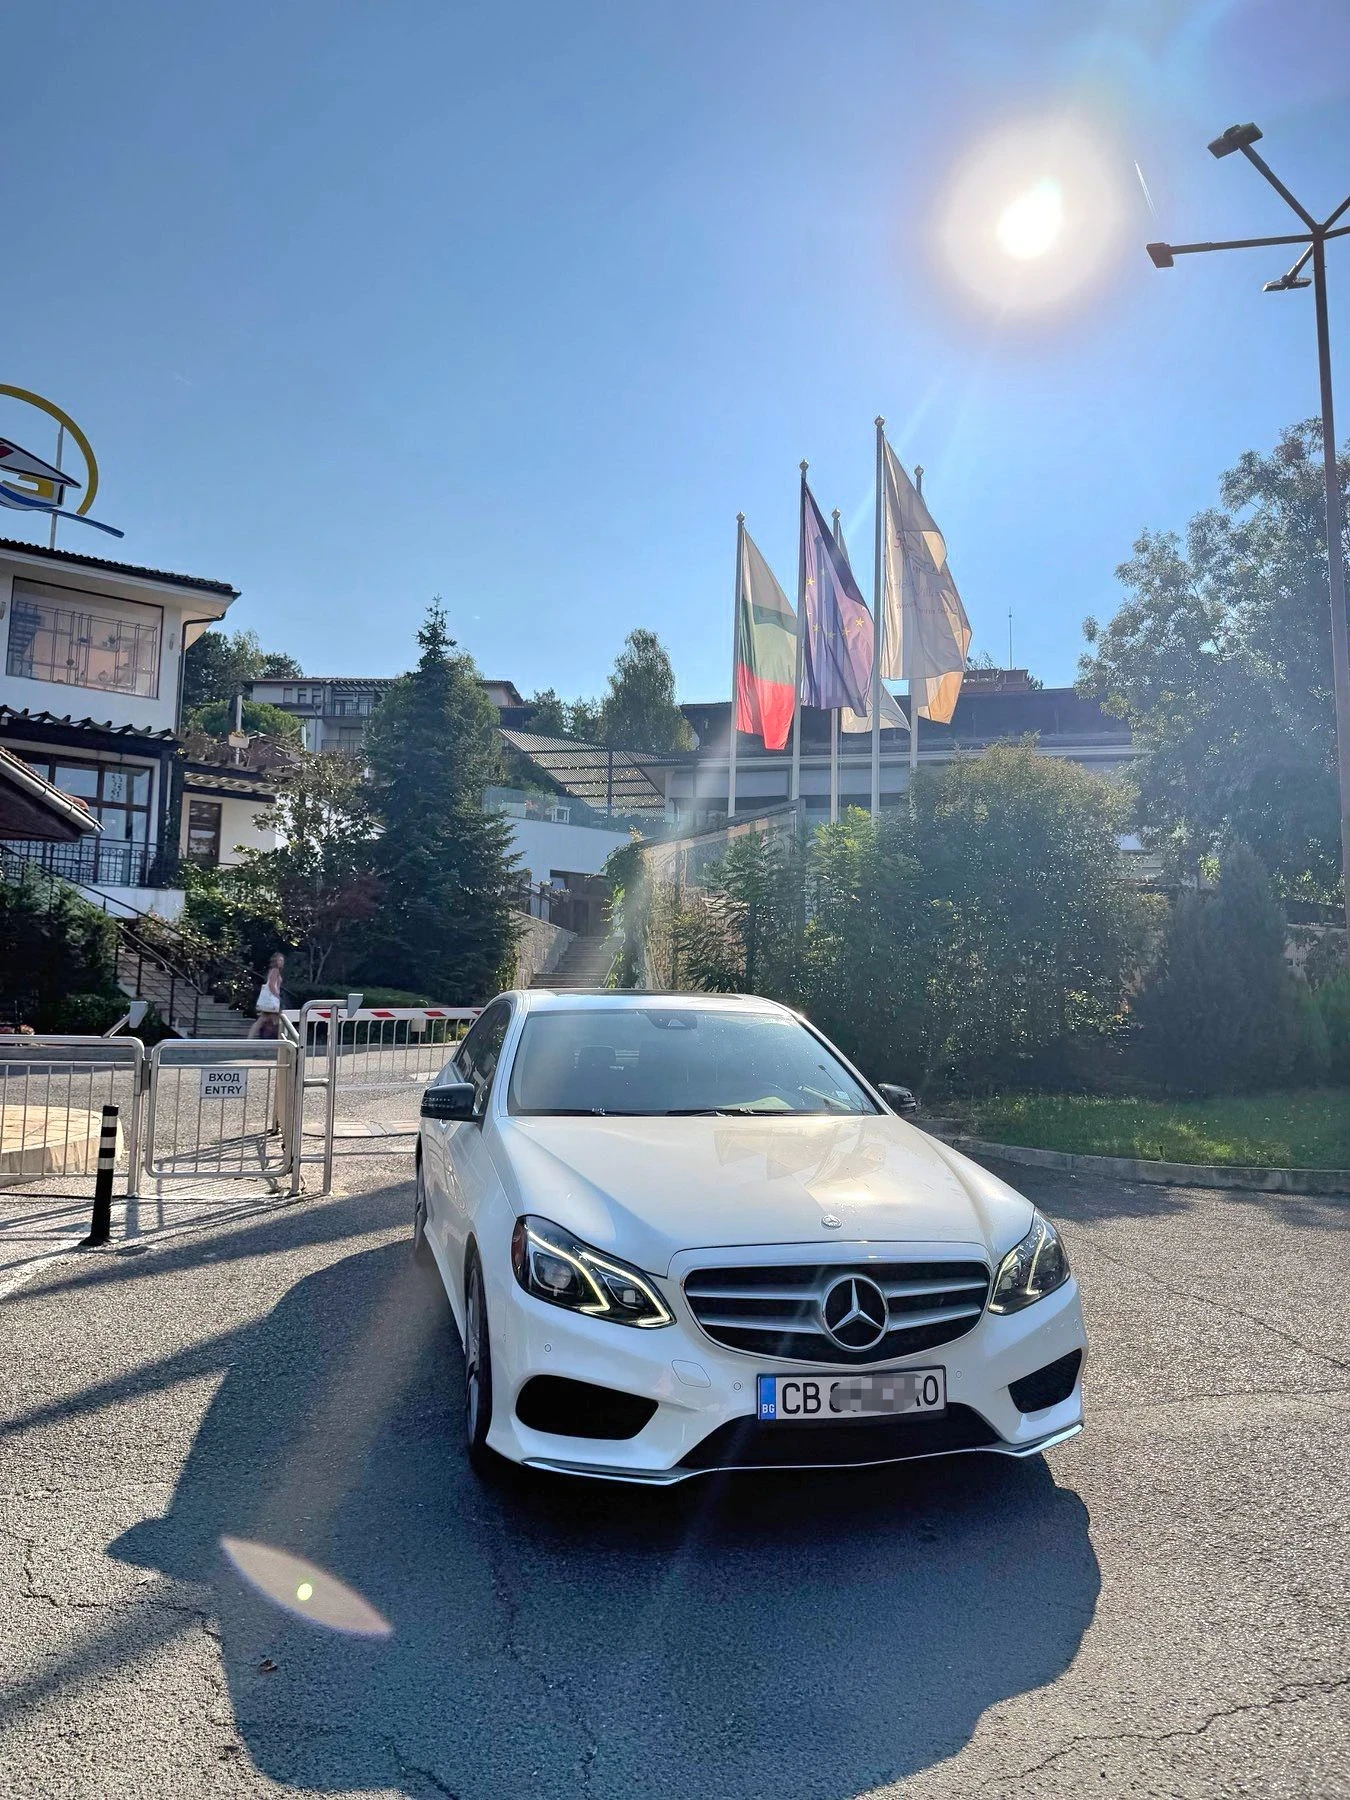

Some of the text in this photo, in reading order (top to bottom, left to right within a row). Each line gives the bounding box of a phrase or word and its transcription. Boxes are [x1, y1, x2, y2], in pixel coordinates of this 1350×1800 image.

[208, 1073, 240, 1082] ВХОД
[205, 1085, 242, 1095] ENTRY
[782, 1382, 821, 1414] CB
[762, 1403, 775, 1414] BG
